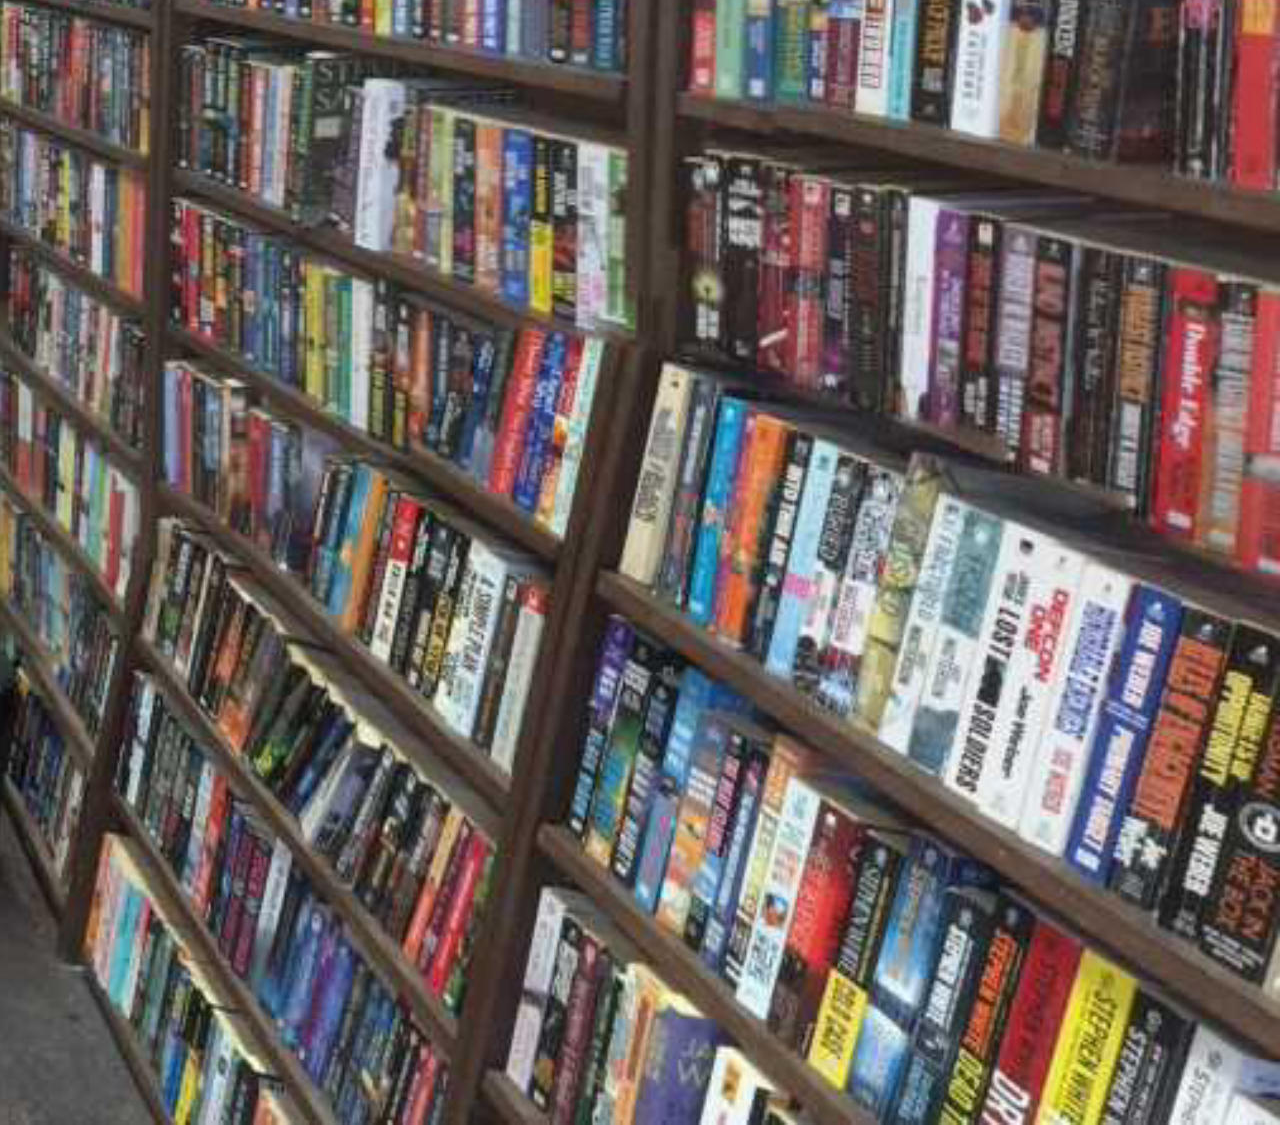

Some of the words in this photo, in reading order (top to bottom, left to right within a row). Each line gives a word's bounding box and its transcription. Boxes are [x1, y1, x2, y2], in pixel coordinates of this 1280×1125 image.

[1180, 321, 1206, 394] Double
[1171, 395, 1200, 450] Edge
[473, 590, 495, 641] SIMPLE
[988, 606, 1021, 663] LOST
[1024, 603, 1048, 653] ONE
[1033, 587, 1072, 684] DEFCON
[462, 639, 484, 674] PLAN
[1015, 685, 1035, 715] Joe
[956, 698, 996, 794] SOLDIERS
[1002, 715, 1028, 782] Weber
[1202, 803, 1230, 830] JOE
[1182, 831, 1224, 898] WEBER
[938, 923, 970, 984] STEPHEN
[1078, 989, 1120, 1063] STEPHEN
[947, 1048, 985, 1109] DEAD
[1057, 1061, 1098, 1125] WHITE
[1110, 1024, 1147, 1113] STEPHEN
